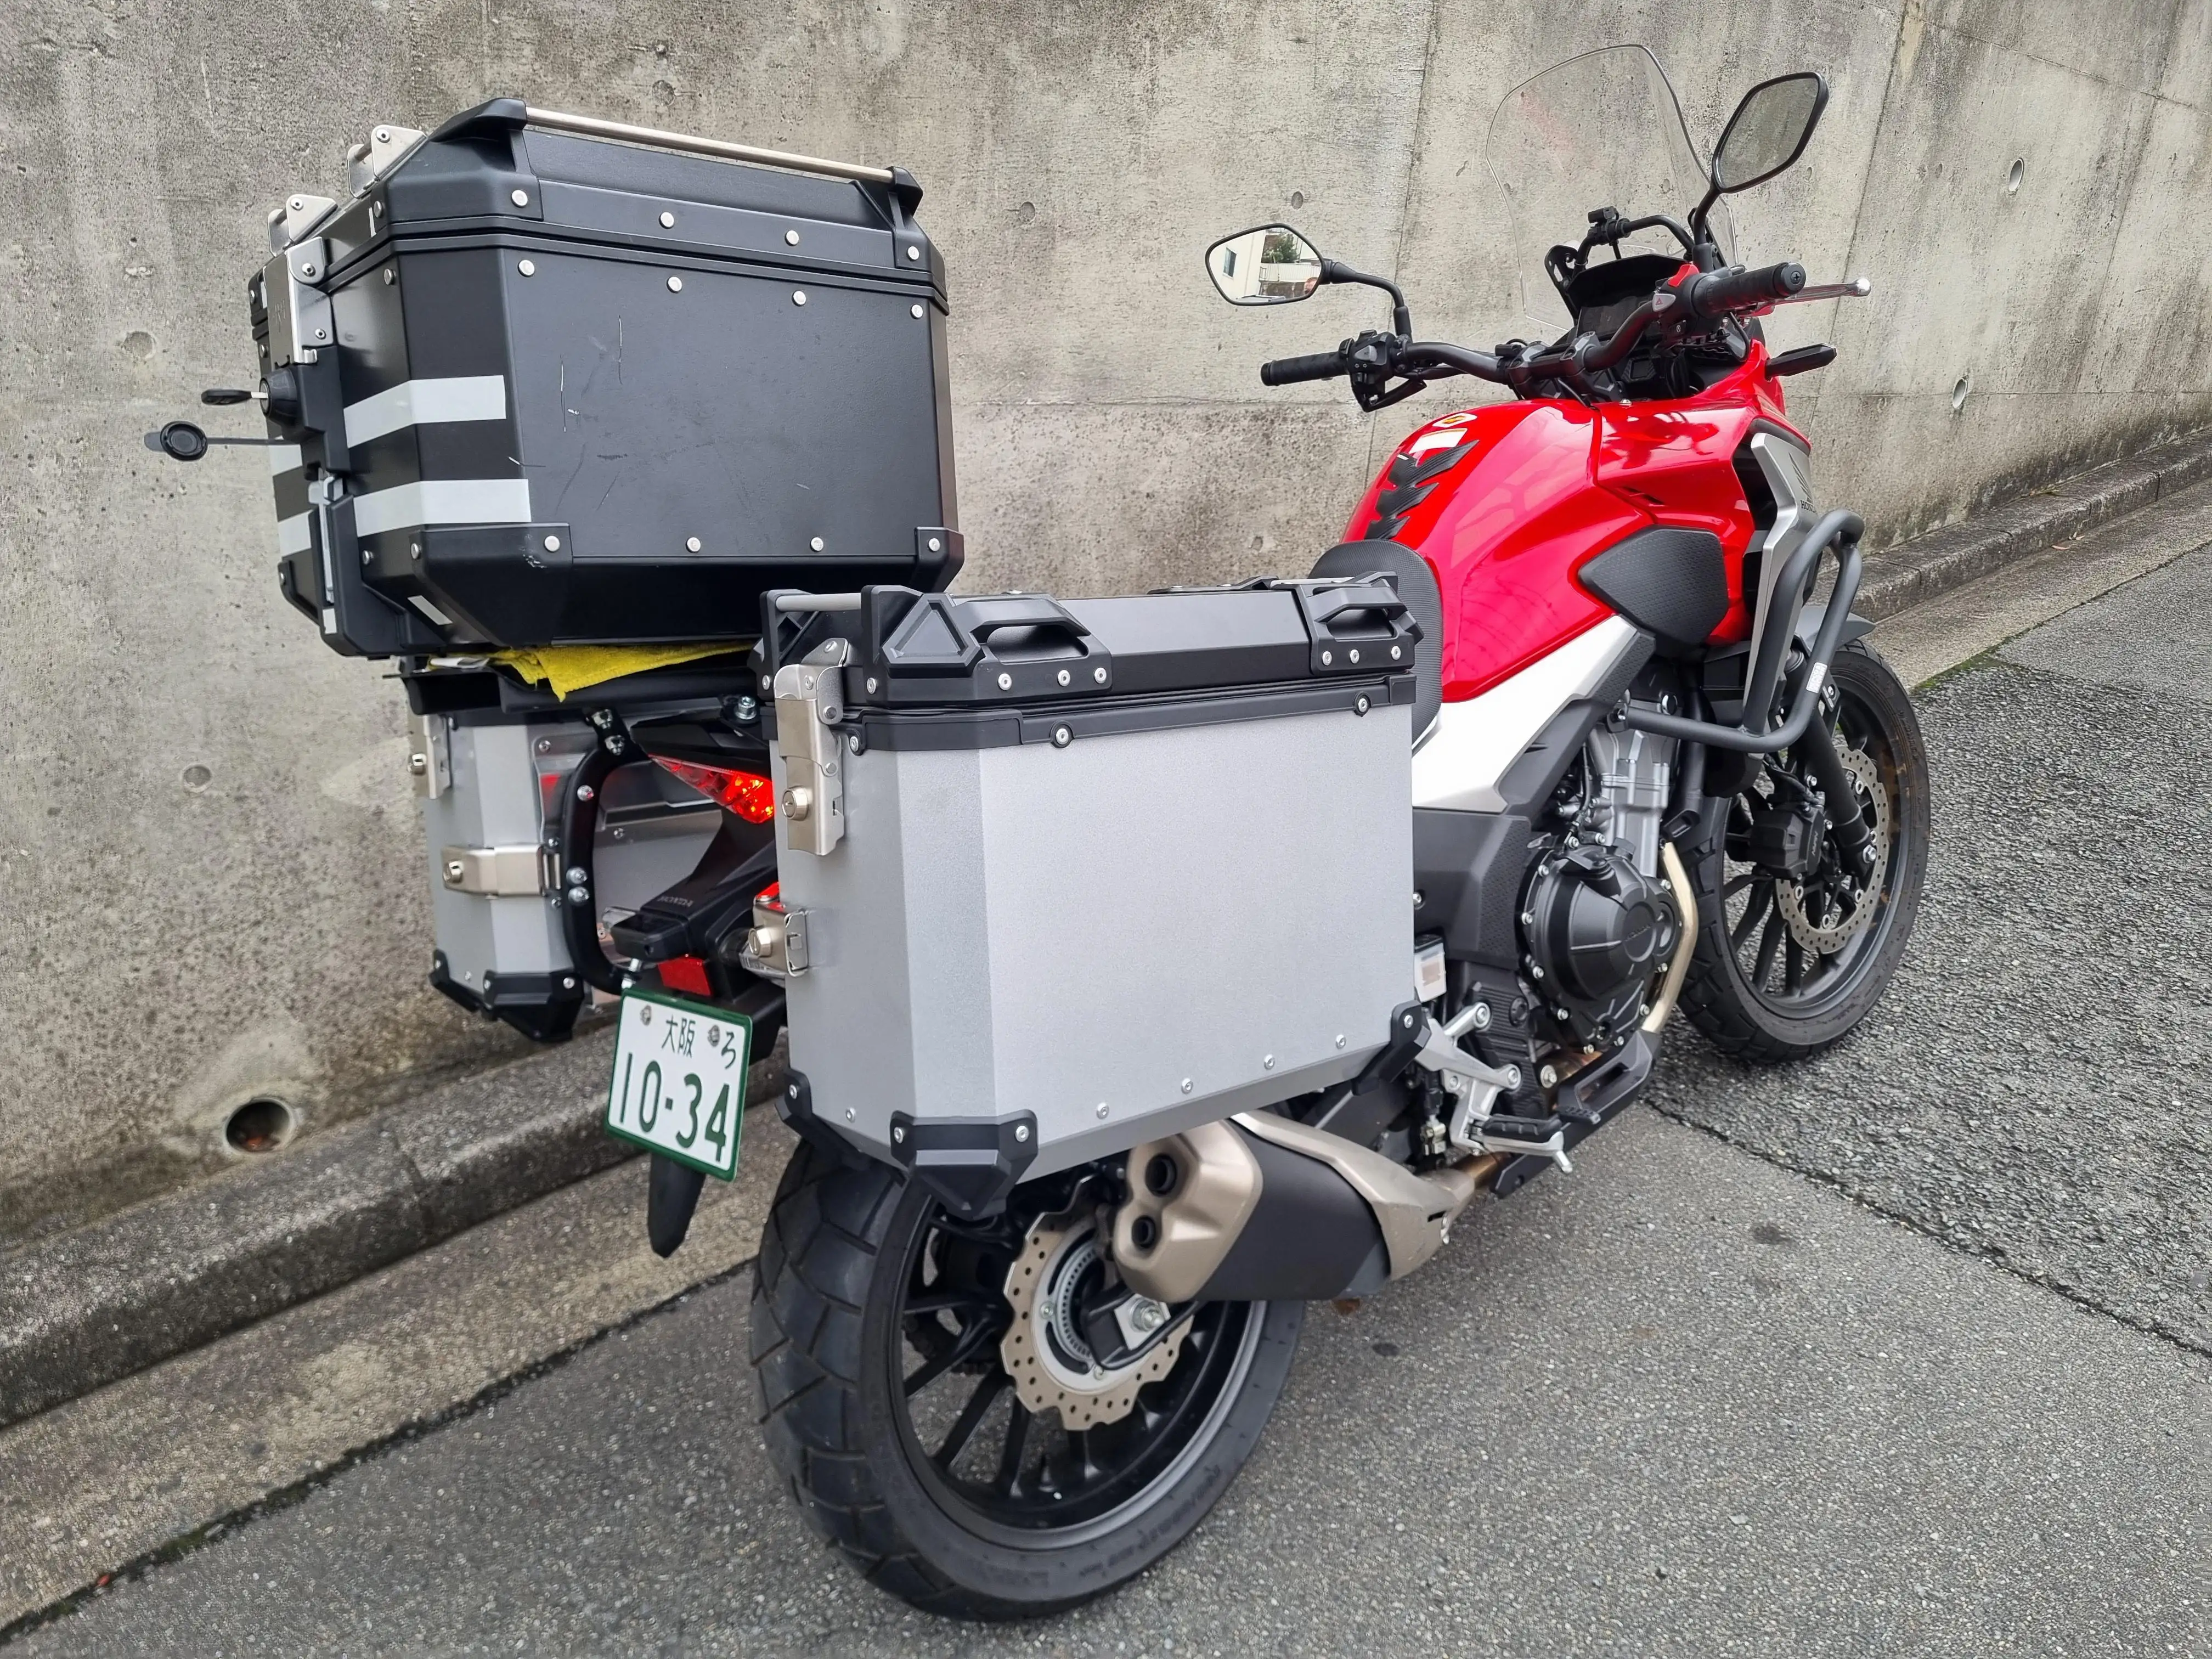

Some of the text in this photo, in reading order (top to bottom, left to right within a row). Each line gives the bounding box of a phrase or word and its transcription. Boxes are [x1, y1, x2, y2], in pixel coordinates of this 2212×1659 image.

[662, 1015, 737, 1069] 大阪 ろ
[619, 1052, 730, 1162] 10-34
